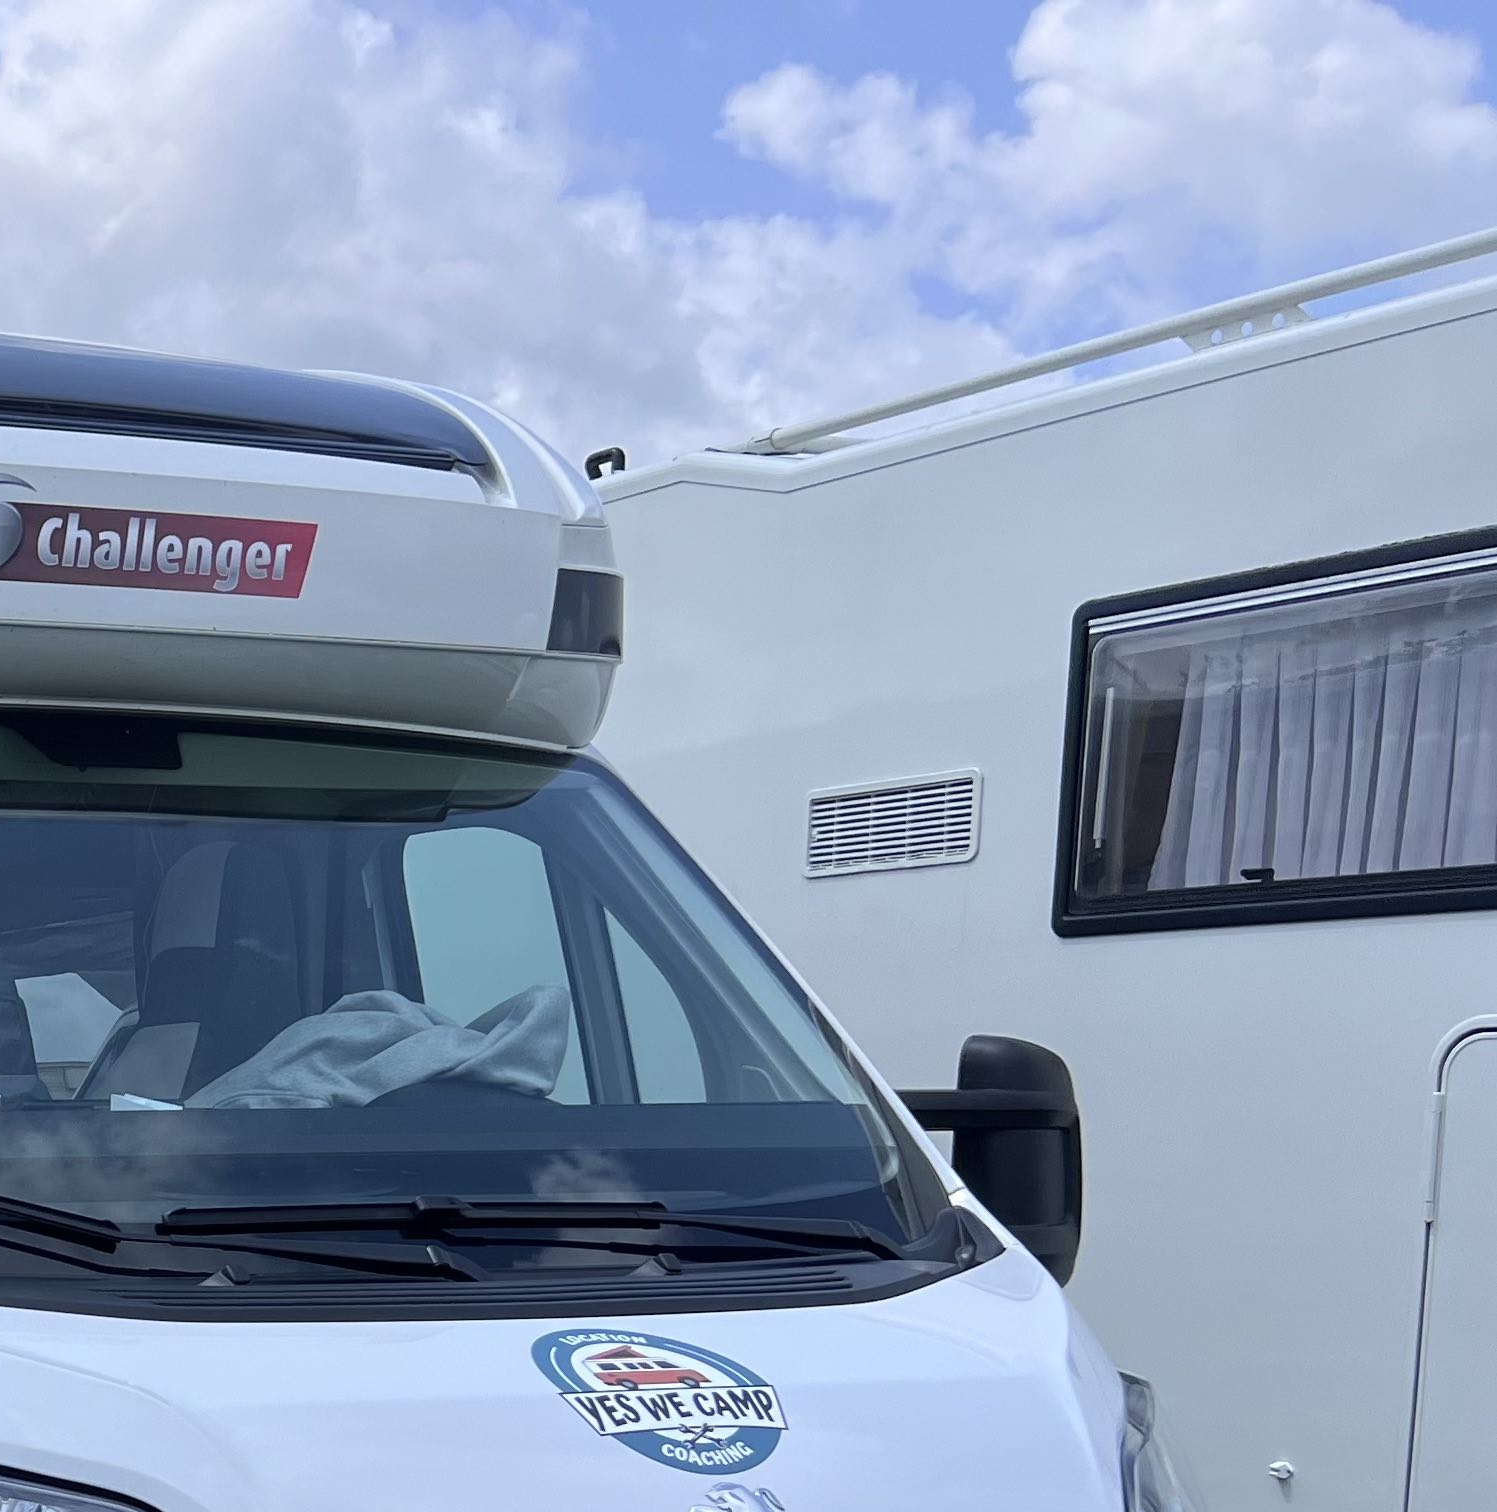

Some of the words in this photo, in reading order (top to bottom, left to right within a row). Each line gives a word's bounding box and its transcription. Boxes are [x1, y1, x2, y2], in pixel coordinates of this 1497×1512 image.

[37, 512, 293, 592] Challenger
[558, 1332, 648, 1346] LOCATION
[574, 1393, 641, 1432] YES
[635, 1391, 693, 1422] WE
[693, 1388, 776, 1422] CAMP
[660, 1440, 754, 1467] COACHING
